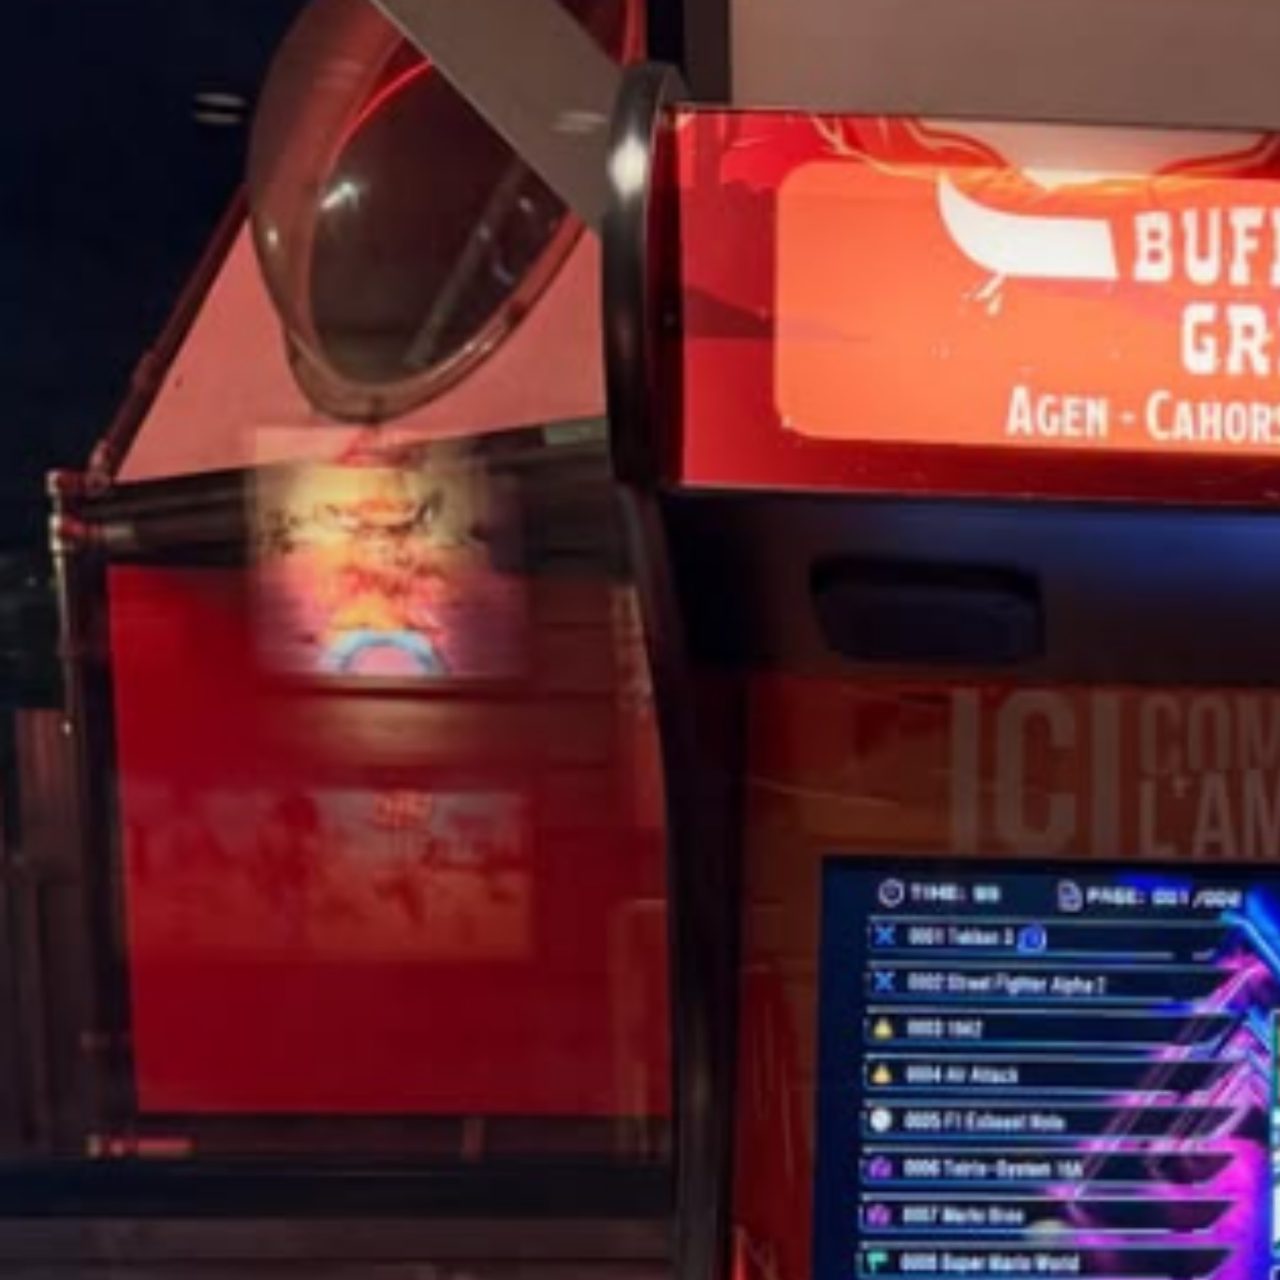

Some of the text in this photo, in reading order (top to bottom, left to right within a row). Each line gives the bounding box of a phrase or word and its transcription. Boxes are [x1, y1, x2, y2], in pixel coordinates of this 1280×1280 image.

[1006, 384, 1110, 441] AGEN
[950, 688, 1121, 857] ICI
[943, 1252, 984, 1274] Super
[988, 1253, 1032, 1272] Mario
[1035, 1253, 1081, 1272] World
